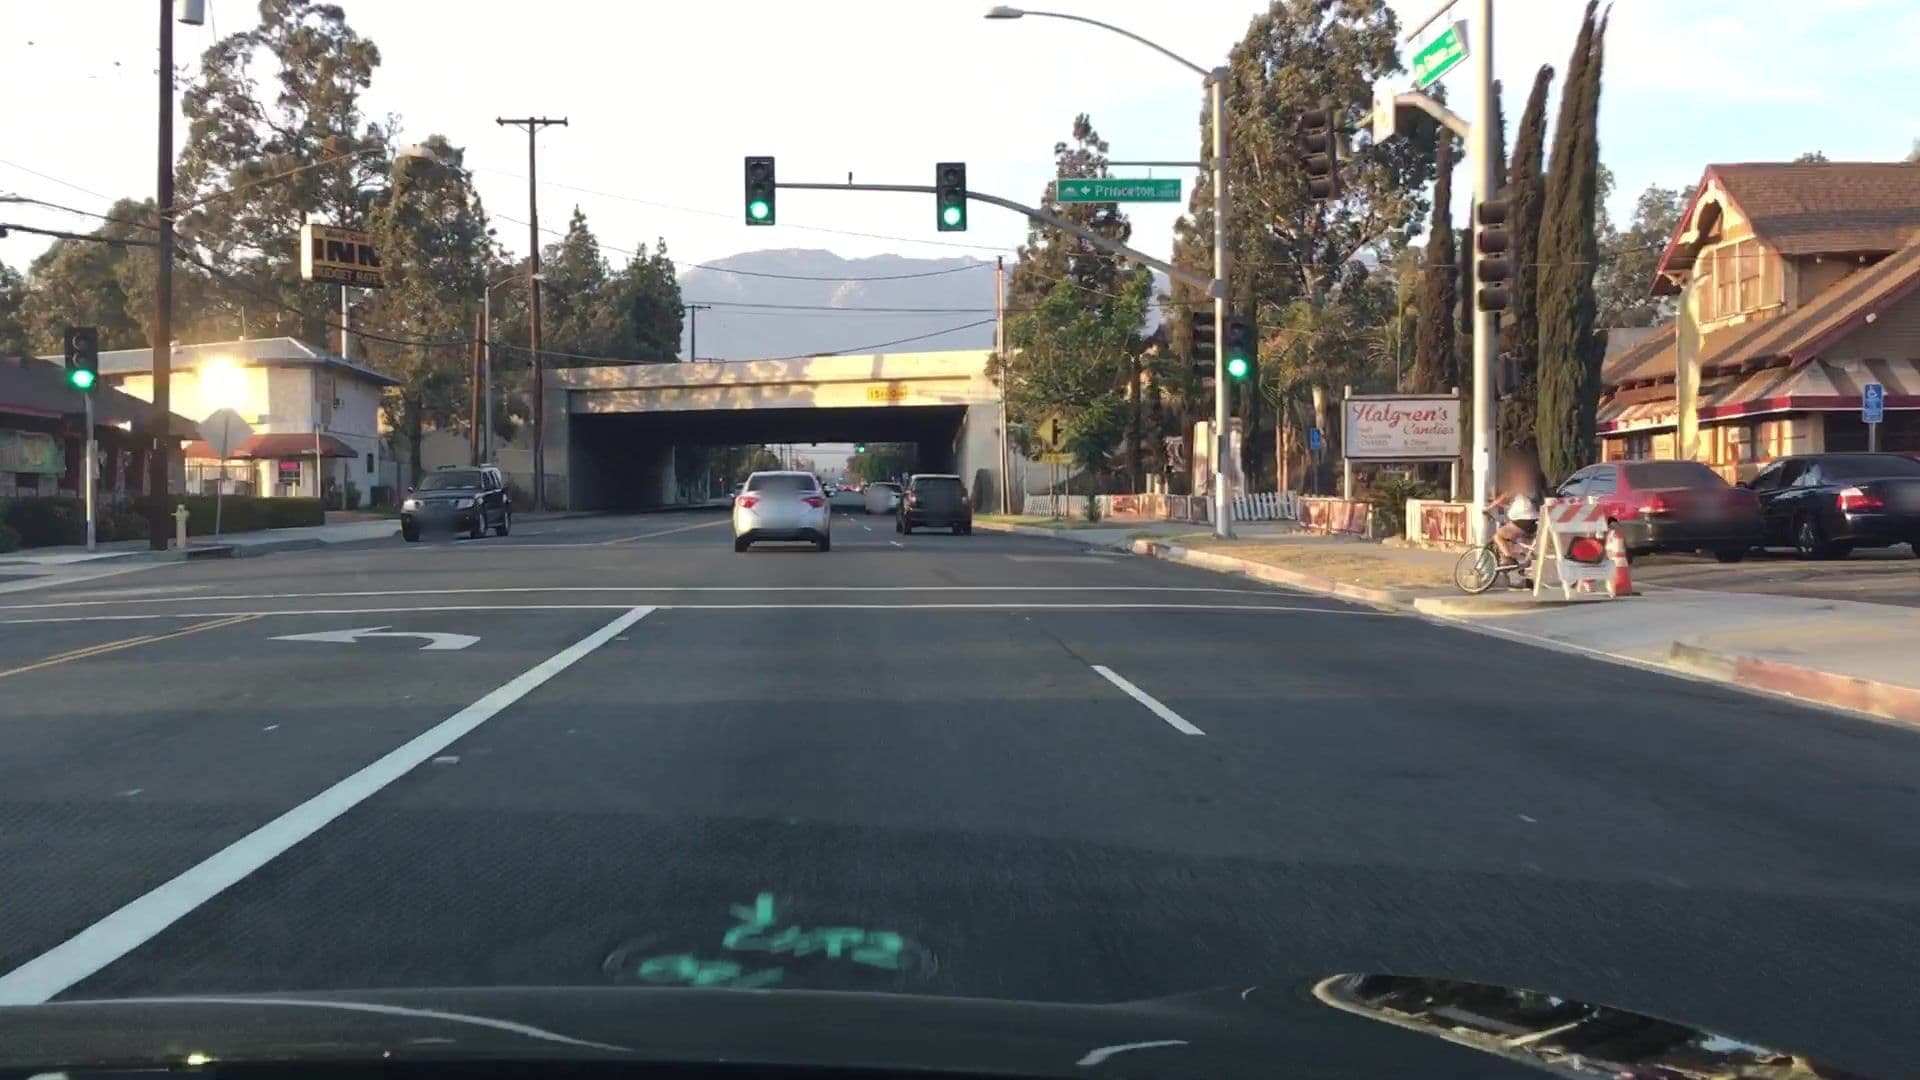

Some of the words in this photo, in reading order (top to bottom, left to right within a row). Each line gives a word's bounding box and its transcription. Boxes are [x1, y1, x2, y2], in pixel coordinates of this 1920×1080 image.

[1094, 184, 1155, 197] Princeton
[313, 238, 381, 268] INN
[1352, 403, 1448, 428] Halgren's
[1403, 422, 1455, 436] Candies
